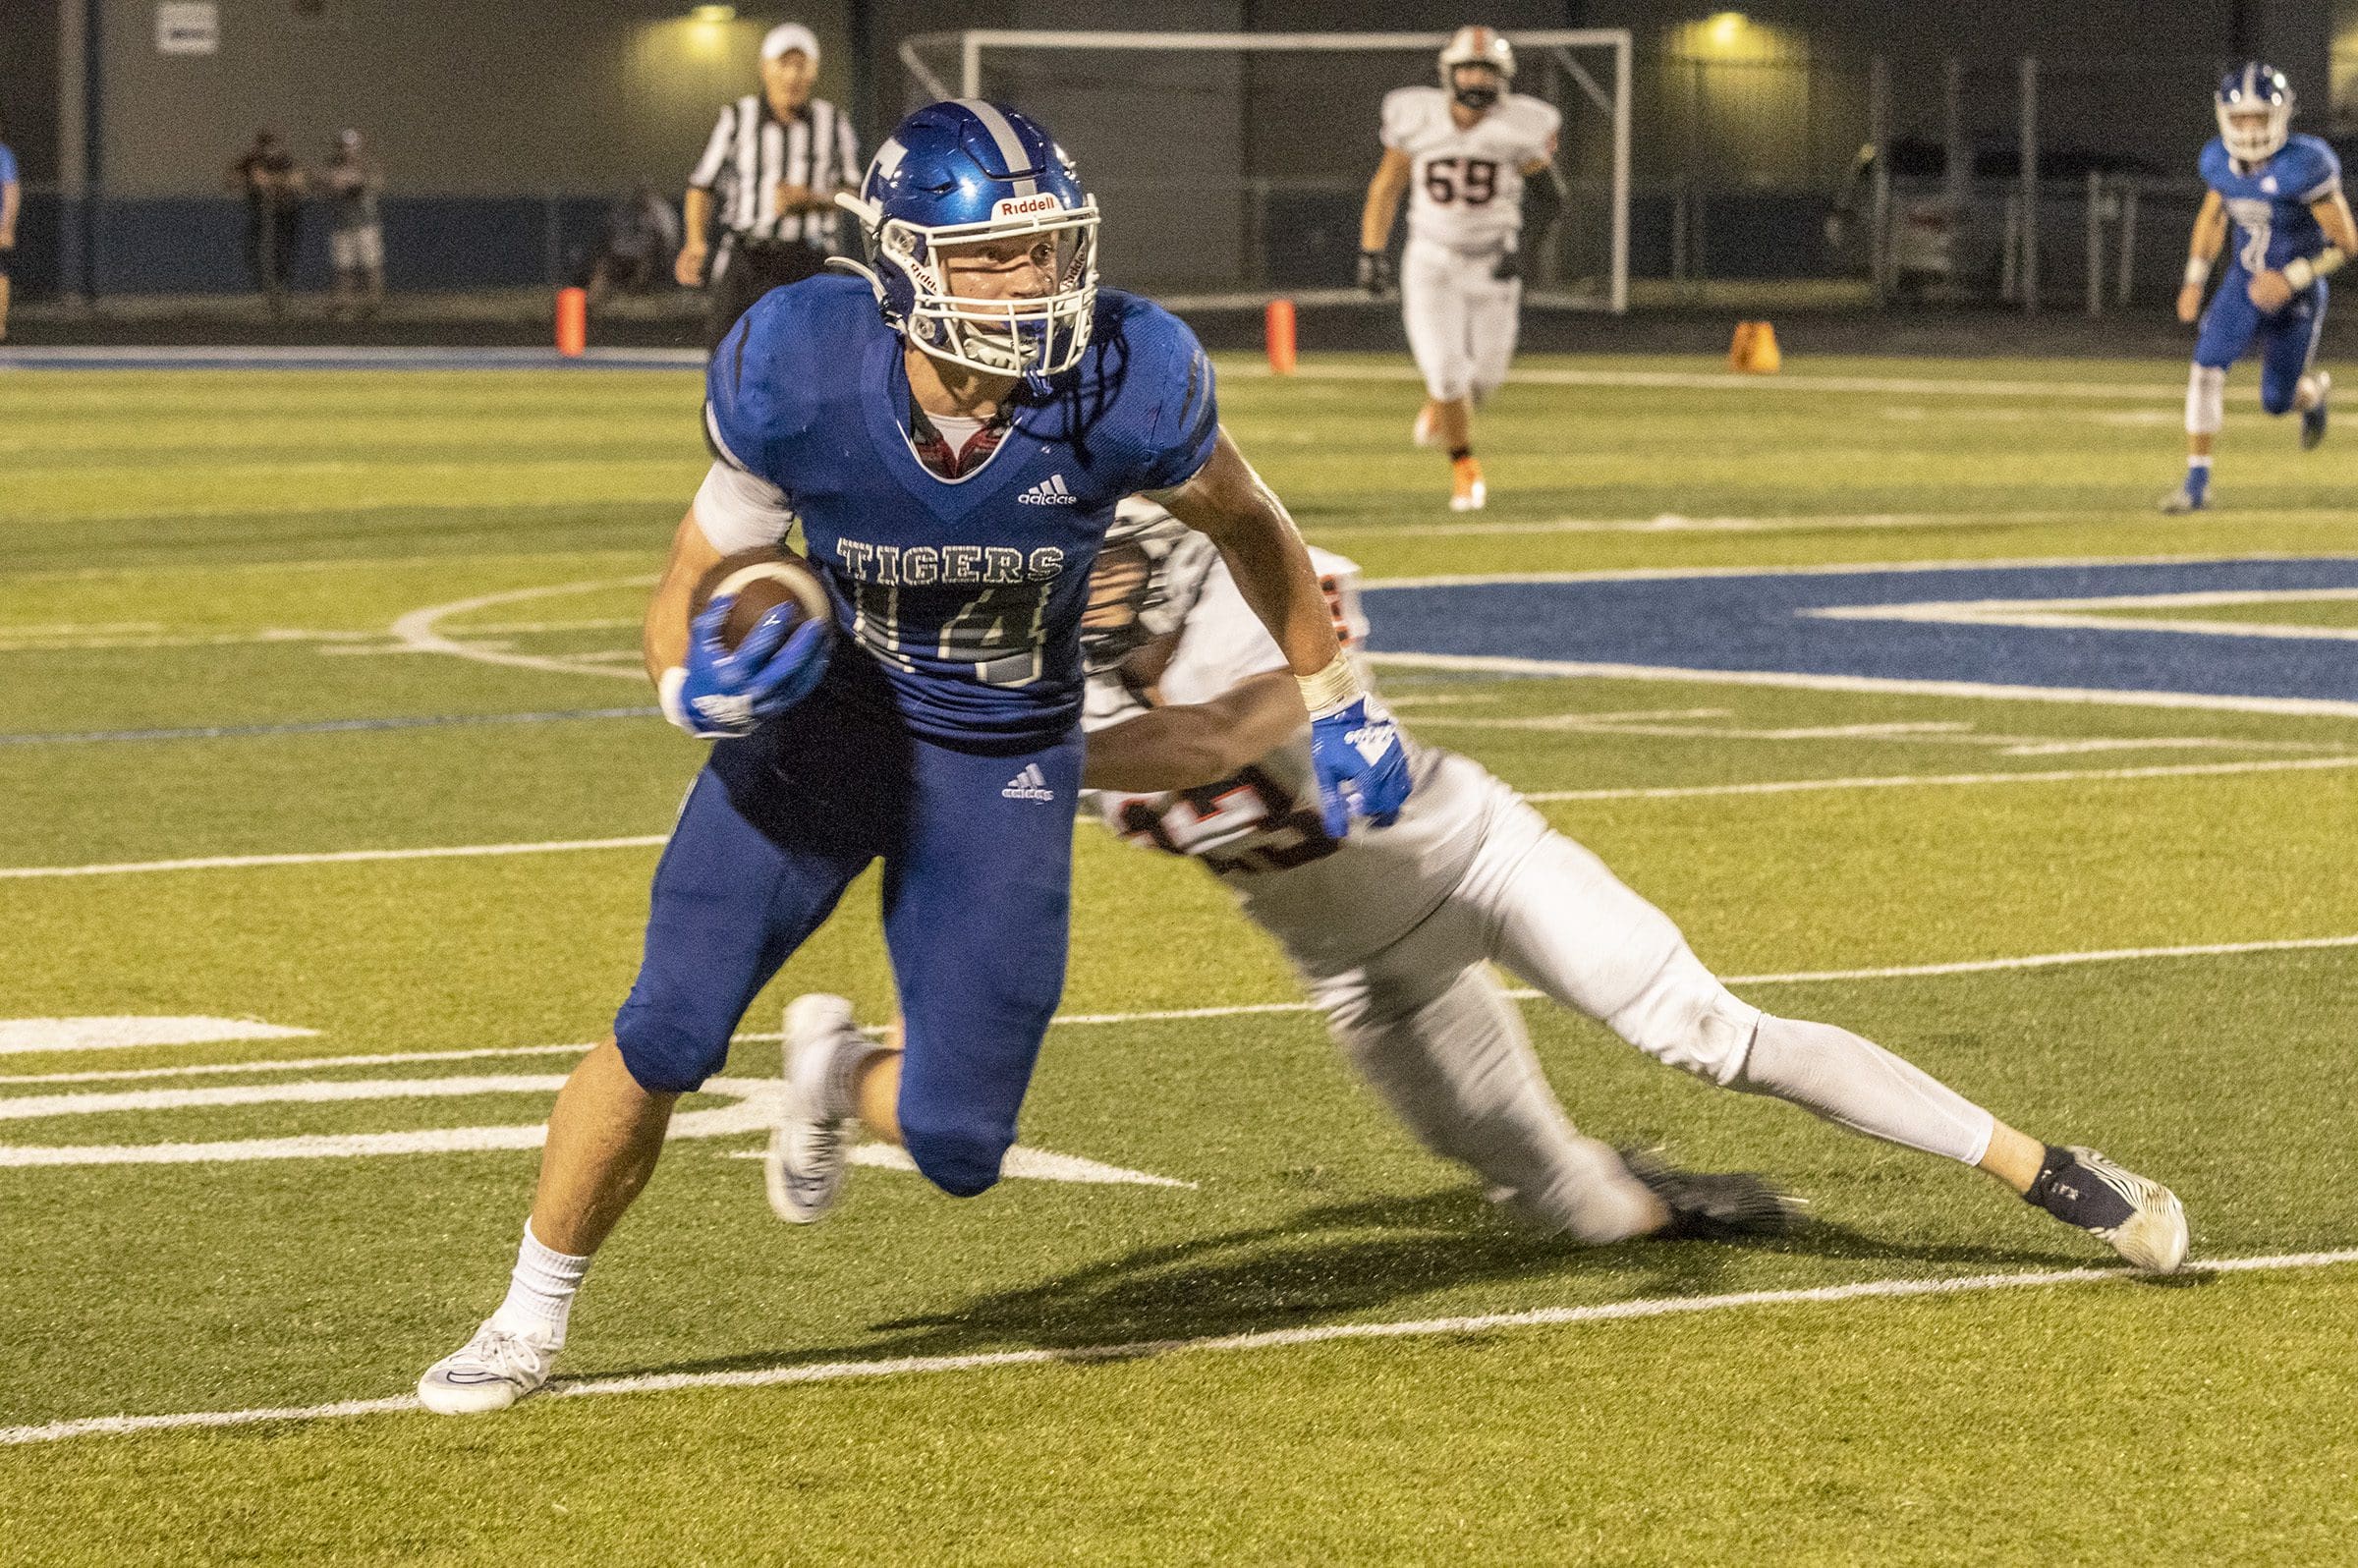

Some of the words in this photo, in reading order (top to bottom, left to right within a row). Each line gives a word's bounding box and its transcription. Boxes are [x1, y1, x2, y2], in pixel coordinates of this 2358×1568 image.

[1426, 157, 1496, 205] 69
[1001, 196, 1055, 215] Riddell
[910, 262, 937, 292] Ridd
[1062, 246, 1086, 287] Ridde
[1017, 491, 1078, 506] adidas
[836, 536, 1064, 587] TIGERS
[851, 581, 1051, 688] 14
